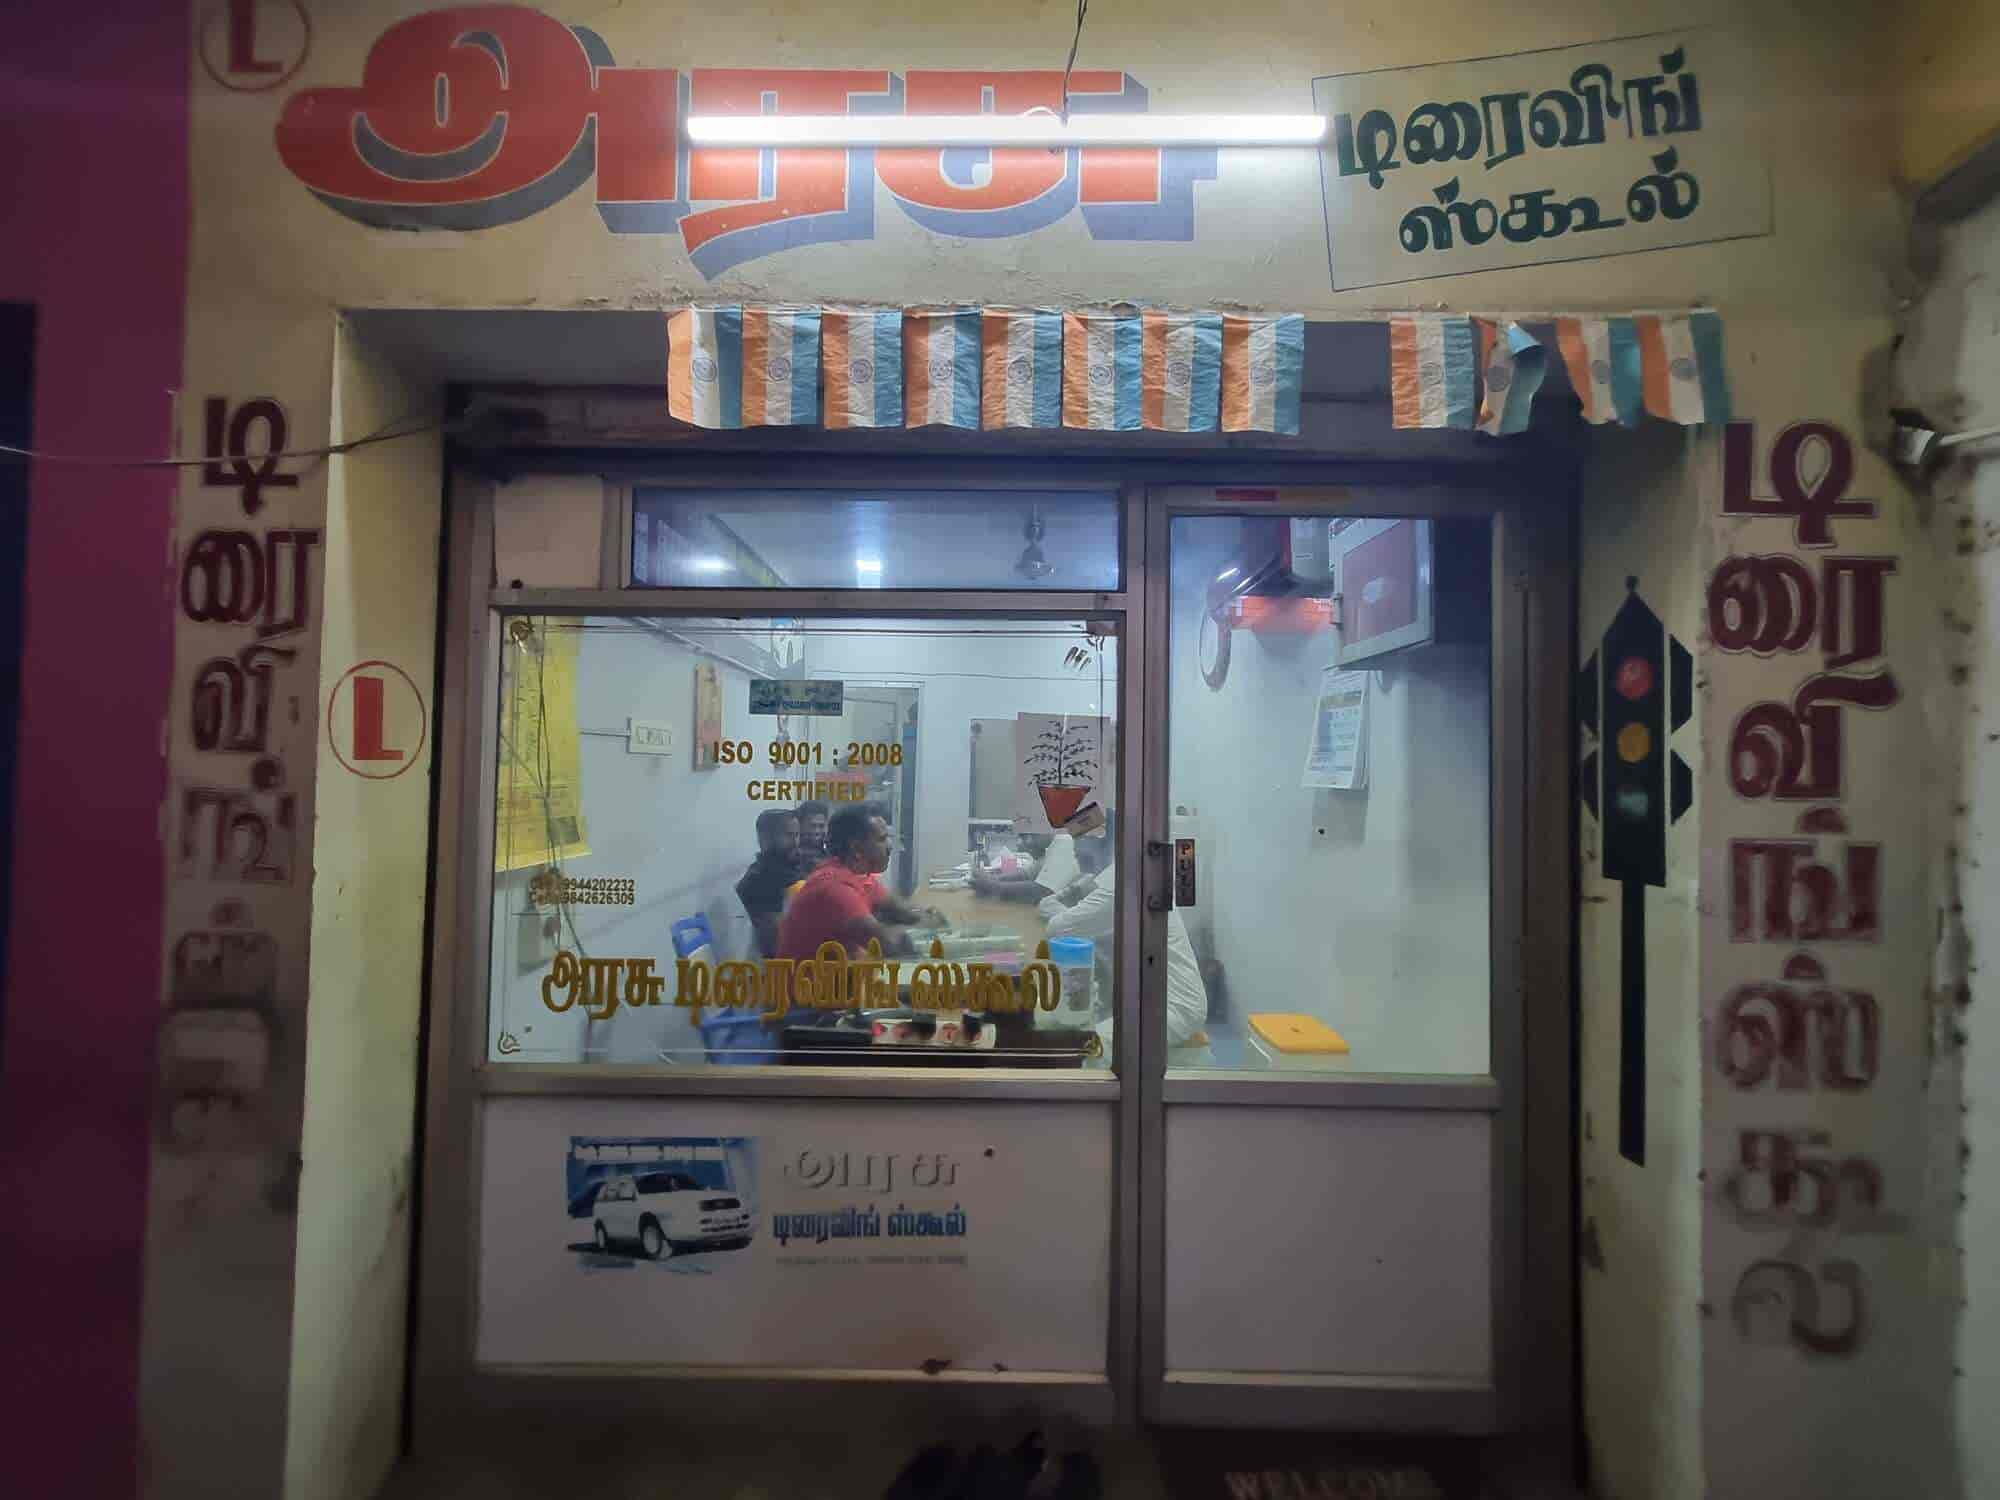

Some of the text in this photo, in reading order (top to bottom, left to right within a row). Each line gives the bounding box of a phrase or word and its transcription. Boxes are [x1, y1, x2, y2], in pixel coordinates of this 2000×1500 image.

[275, 3, 1217, 280] அரசு
[1333, 46, 1701, 189] டிரைவிங்
[1400, 146, 1699, 253] ஸ்கூல்
[353, 676, 403, 760] L
[713, 742, 753, 764] ISO
[769, 742, 822, 765] 9001
[847, 742, 902, 766] 2008
[747, 780, 866, 801] CERTIFIED
[542, 936, 1061, 1025] அரசு டிரைவிங் ஸ்கூல்
